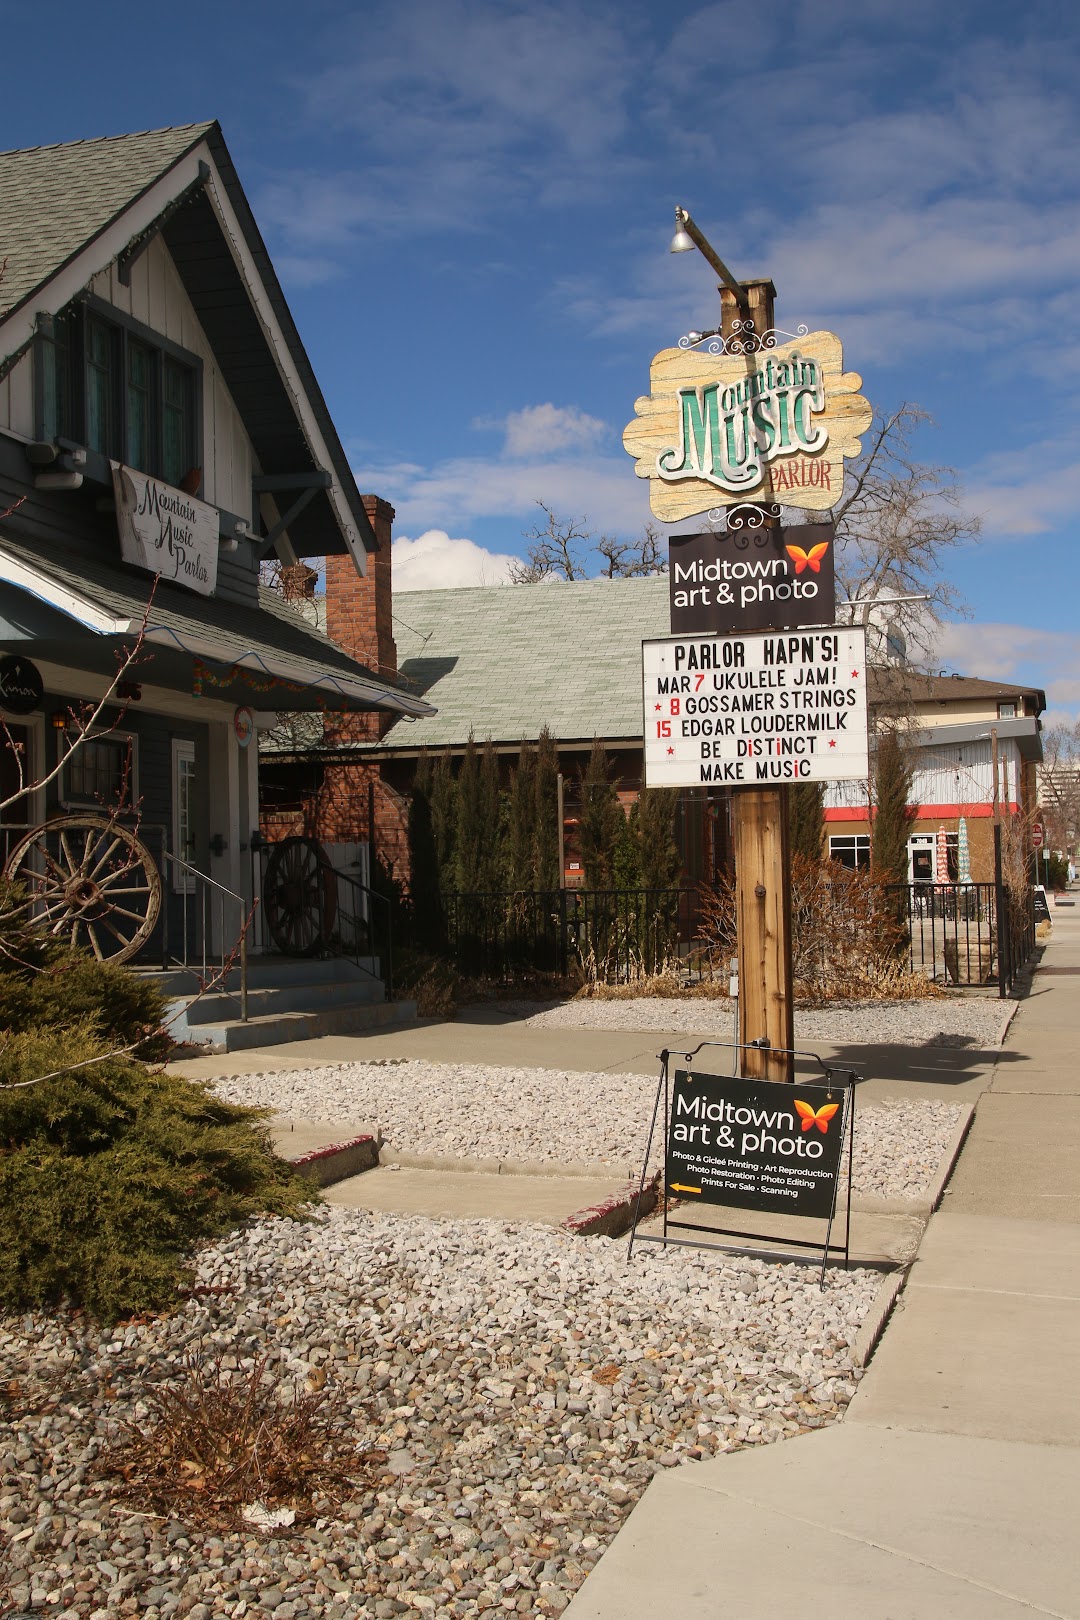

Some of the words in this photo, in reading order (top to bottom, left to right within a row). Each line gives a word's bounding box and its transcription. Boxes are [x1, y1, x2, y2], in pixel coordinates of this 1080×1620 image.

[768, 458, 832, 493] PARLOR
[138, 480, 197, 523] Mountain
[155, 516, 194, 556] Music
[172, 543, 208, 583] Parlor
[674, 558, 788, 583] Midtown
[674, 584, 711, 608] art
[716, 582, 735, 605] &
[740, 579, 819, 609] photo
[674, 641, 745, 671] PARLOR
[763, 635, 839, 665] HAPN'S!
[657, 676, 690, 695] MAR
[694, 674, 705, 692] 7
[713, 669, 786, 691] UKULELE
[793, 667, 837, 686] JAM!
[670, 698, 680, 716] 8
[685, 693, 774, 715] GOSSAMER
[780, 688, 856, 709] STRINGS
[656, 720, 672, 738] 15
[681, 717, 735, 737] EDGAR
[741, 711, 848, 734] LOUDERMILK
[701, 740, 721, 759] BE
[700, 762, 744, 782] MAKE
[676, 1093, 794, 1131] Midtown
[673, 1123, 711, 1145] art
[716, 1125, 735, 1148] &
[741, 1129, 824, 1159] photo
[672, 1150, 695, 1161] Photo
[695, 1154, 702, 1162] &
[727, 1159, 759, 1171] Printing
[764, 1164, 777, 1173] Art
[778, 1165, 833, 1179] Reproduction
[687, 1164, 710, 1175] Photo
[711, 1168, 755, 1180] Restoration
[761, 1174, 785, 1185] Photo
[786, 1178, 815, 1190] Editing
[701, 1177, 724, 1188] Prints
[724, 1180, 737, 1189] For
[738, 1183, 755, 1192] Sale
[760, 1185, 798, 1198] Scanning
